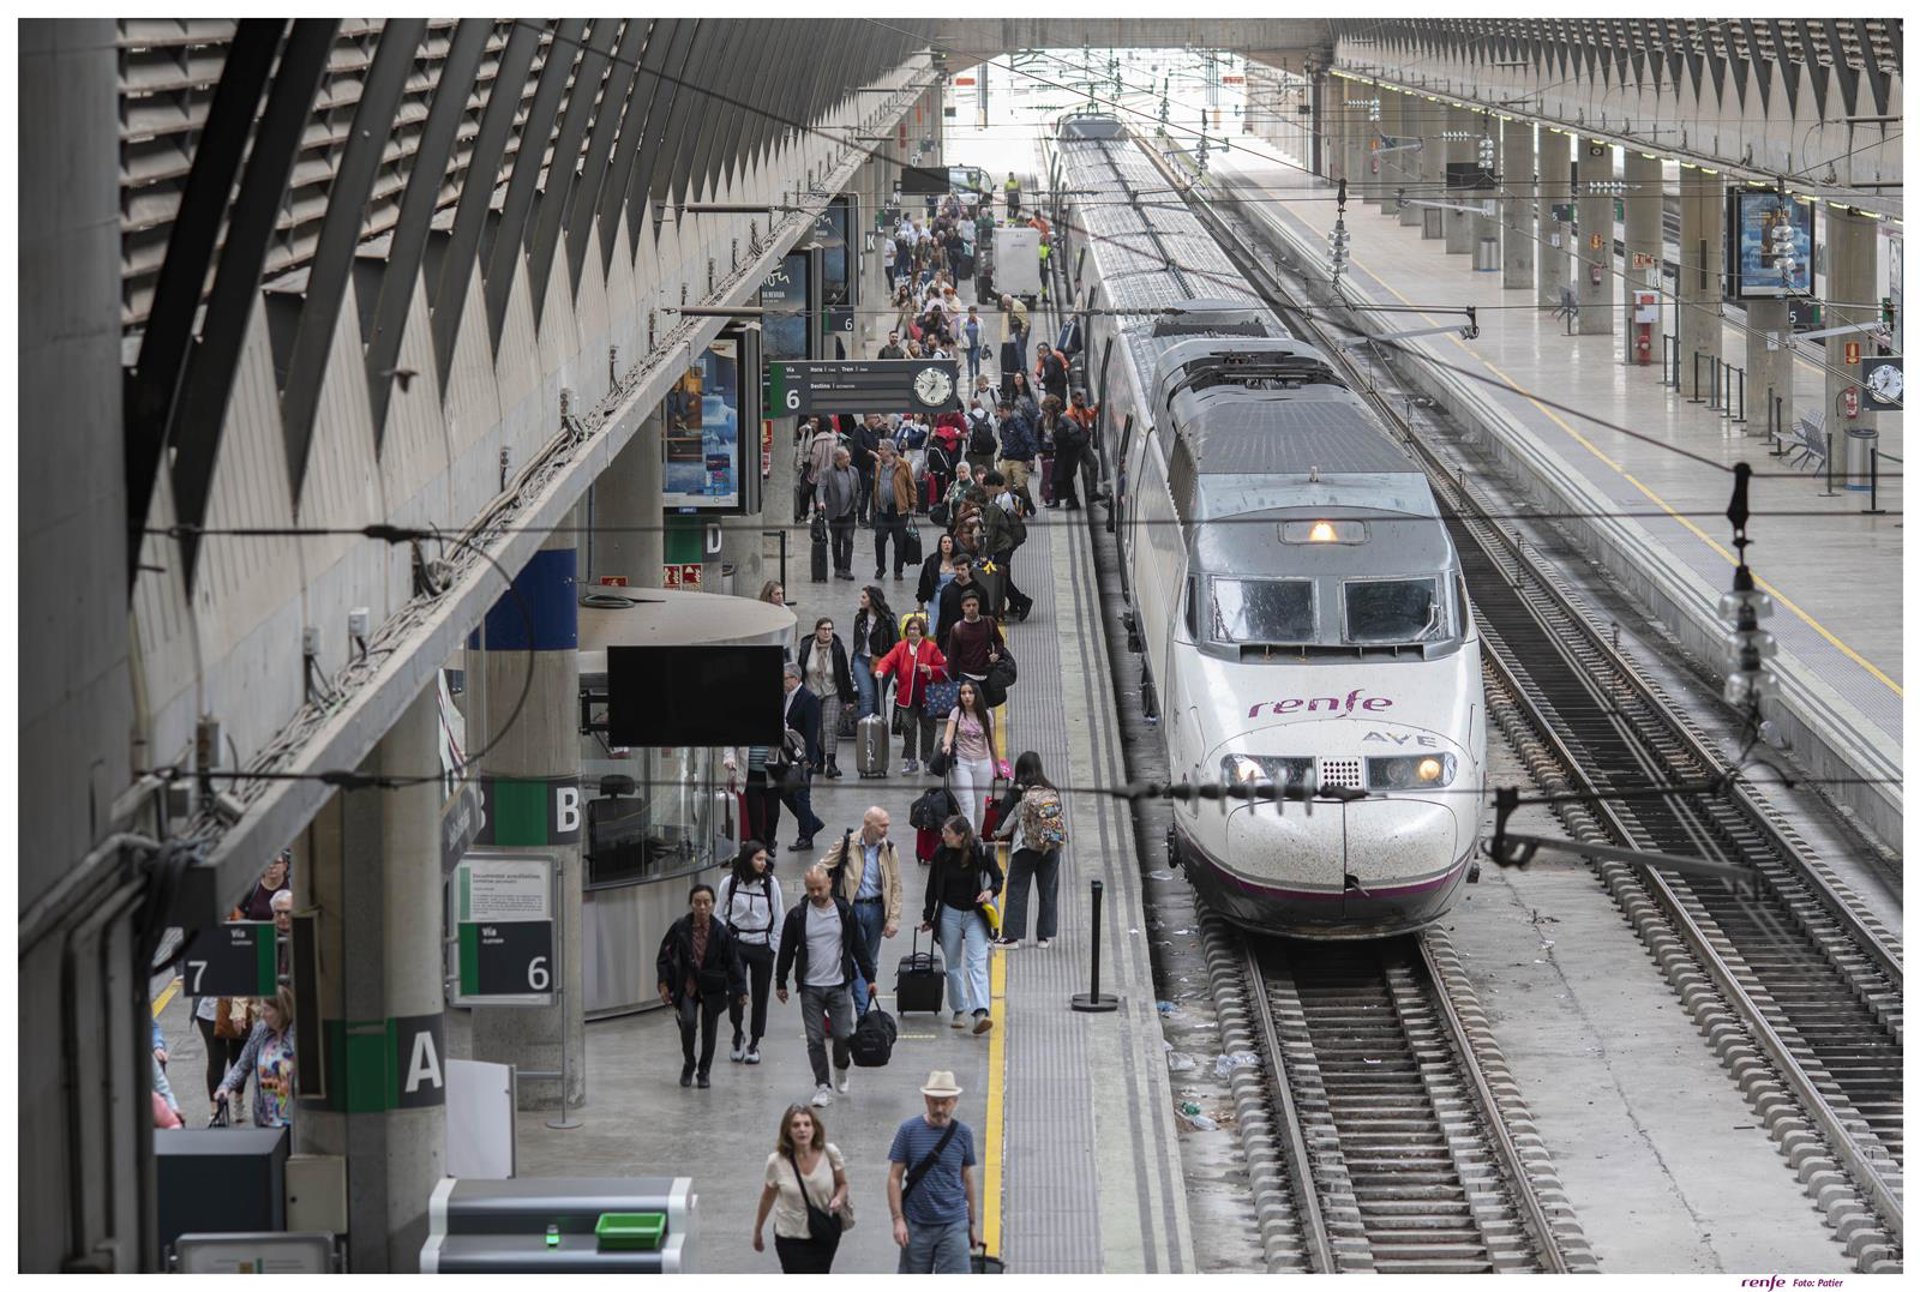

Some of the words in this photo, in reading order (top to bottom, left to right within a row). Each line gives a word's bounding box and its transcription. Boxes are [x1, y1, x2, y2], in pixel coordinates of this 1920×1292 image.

[867, 234, 875, 250] K
[845, 318, 853, 331] 6
[1789, 311, 1797, 323] 5
[786, 389, 800, 409] 6
[706, 523, 722, 554] D
[1248, 689, 1393, 718] renfe
[1363, 731, 1437, 748] AVE
[556, 786, 580, 833] B
[187, 961, 208, 993] 7
[528, 956, 549, 990] 6
[405, 1030, 443, 1093] A
